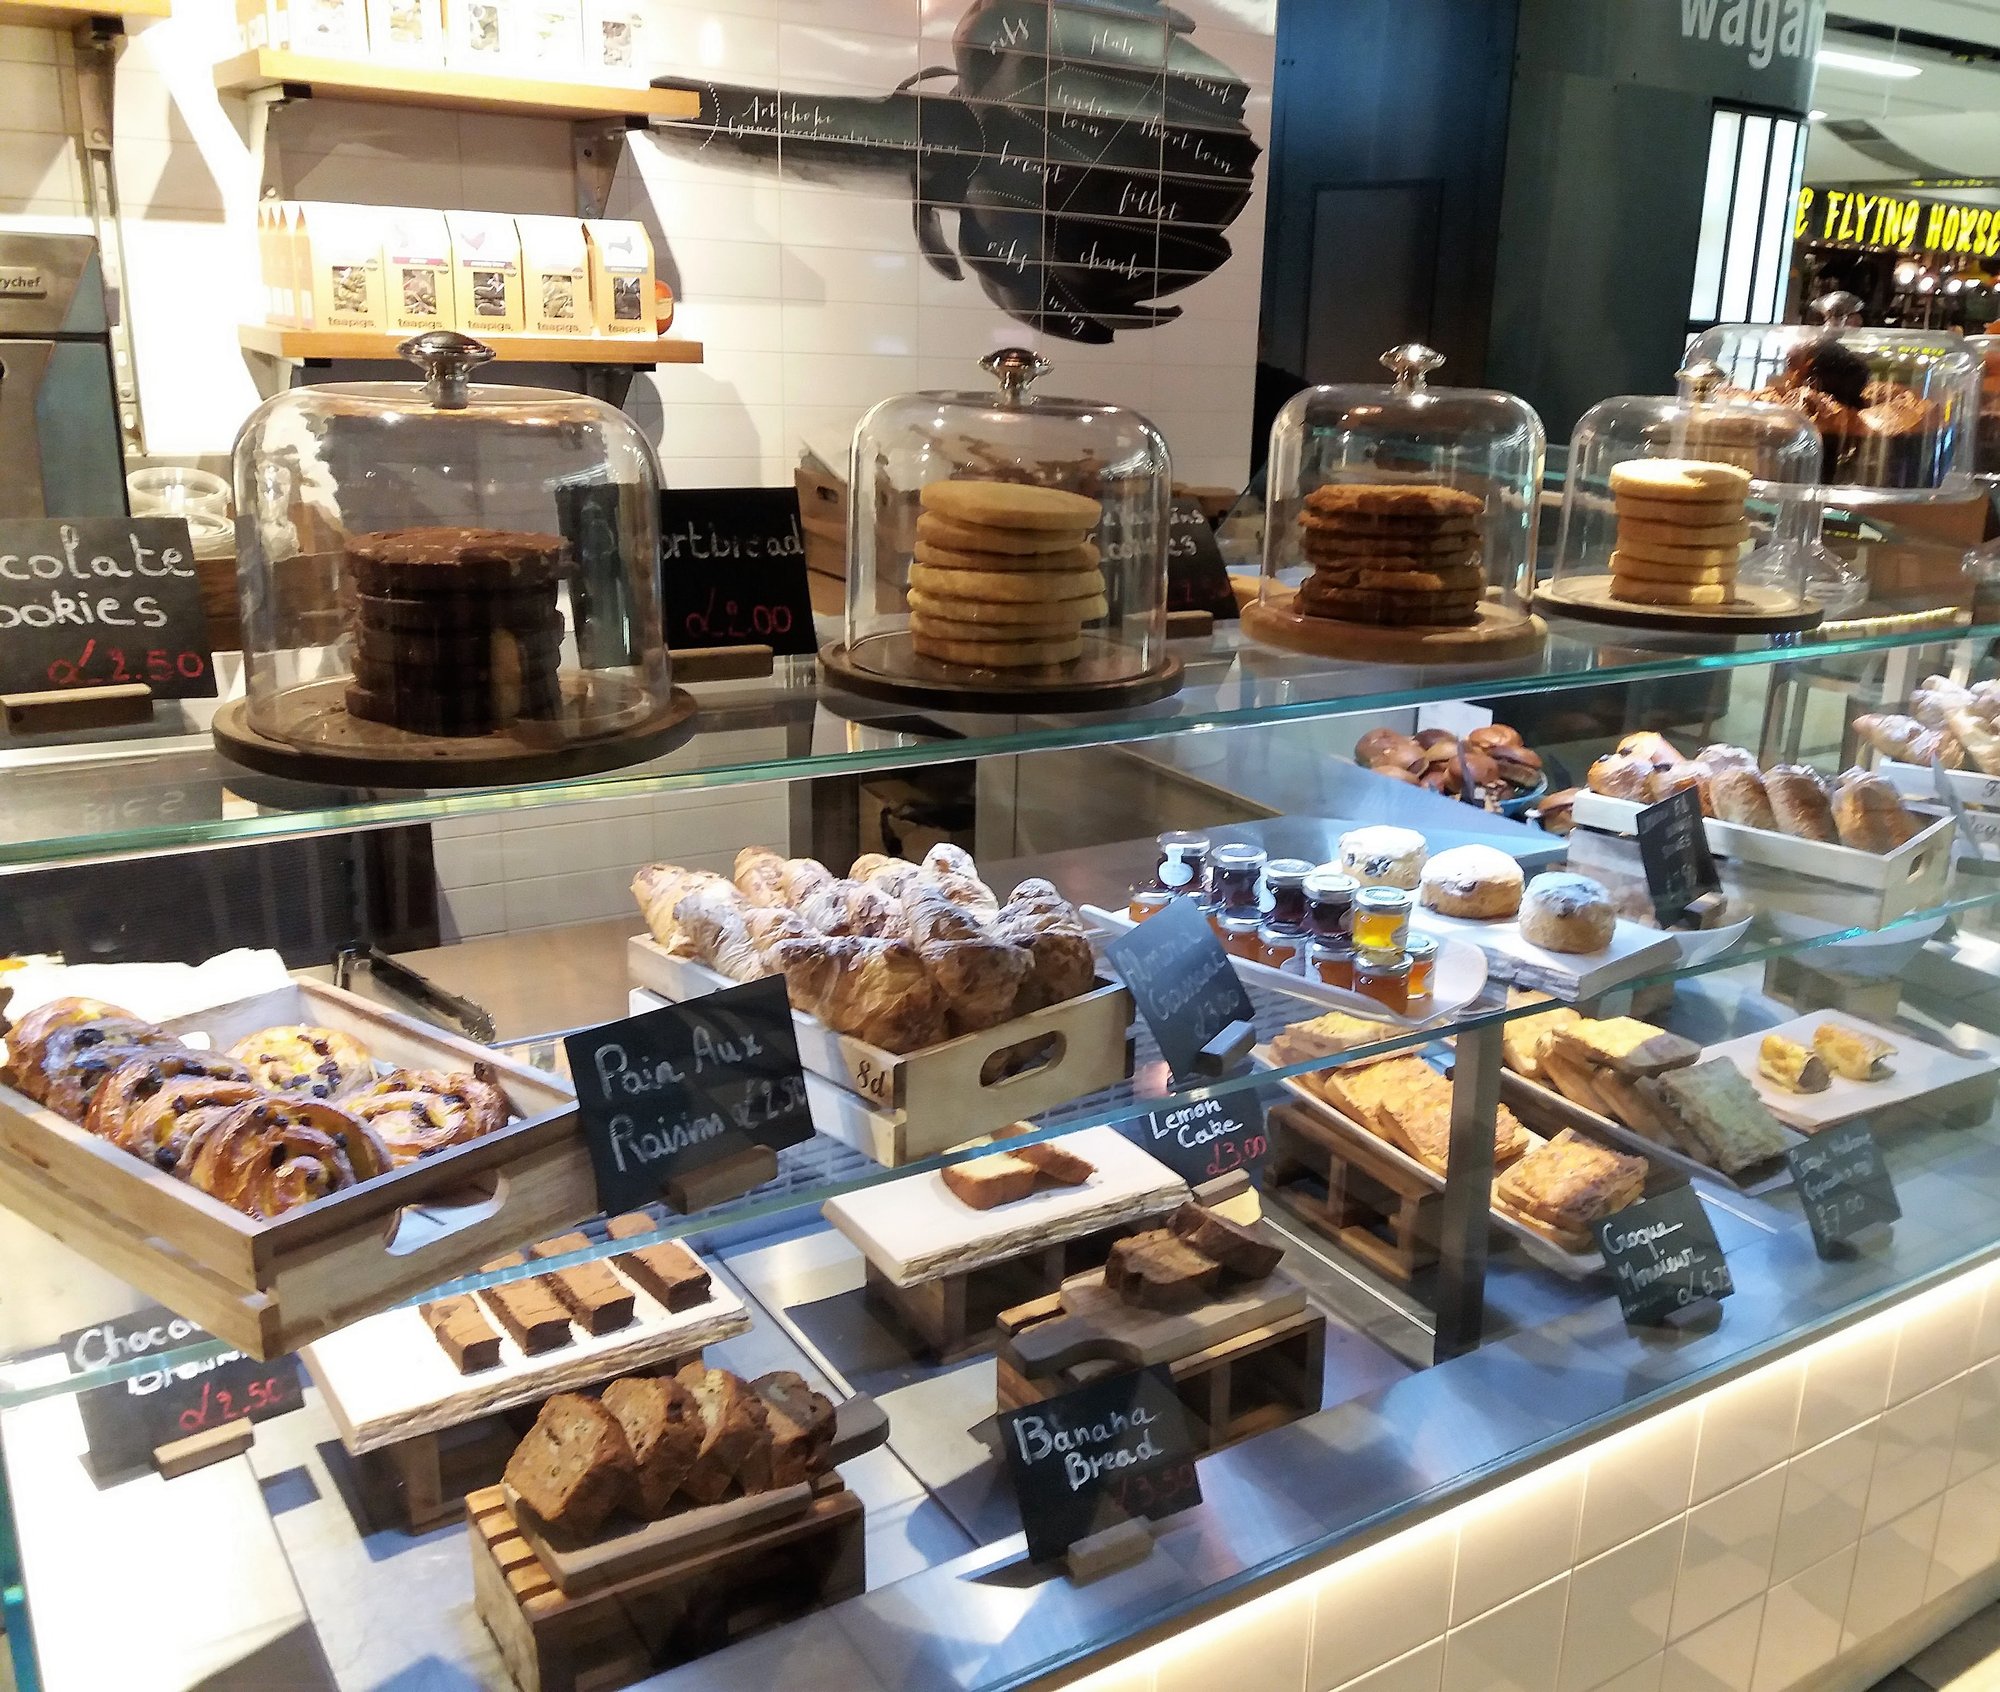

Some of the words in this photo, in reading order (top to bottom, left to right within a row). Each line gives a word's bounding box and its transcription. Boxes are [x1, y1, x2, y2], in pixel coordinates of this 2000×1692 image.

[1823, 190, 1921, 249] FLYING
[594, 1043, 686, 1100] Pain
[693, 1026, 763, 1074] Aux
[1149, 1099, 1222, 1140] Lemon
[1177, 1118, 1244, 1149] Cake
[1012, 1407, 1162, 1466] Banana
[1064, 1428, 1164, 1492] Bread
